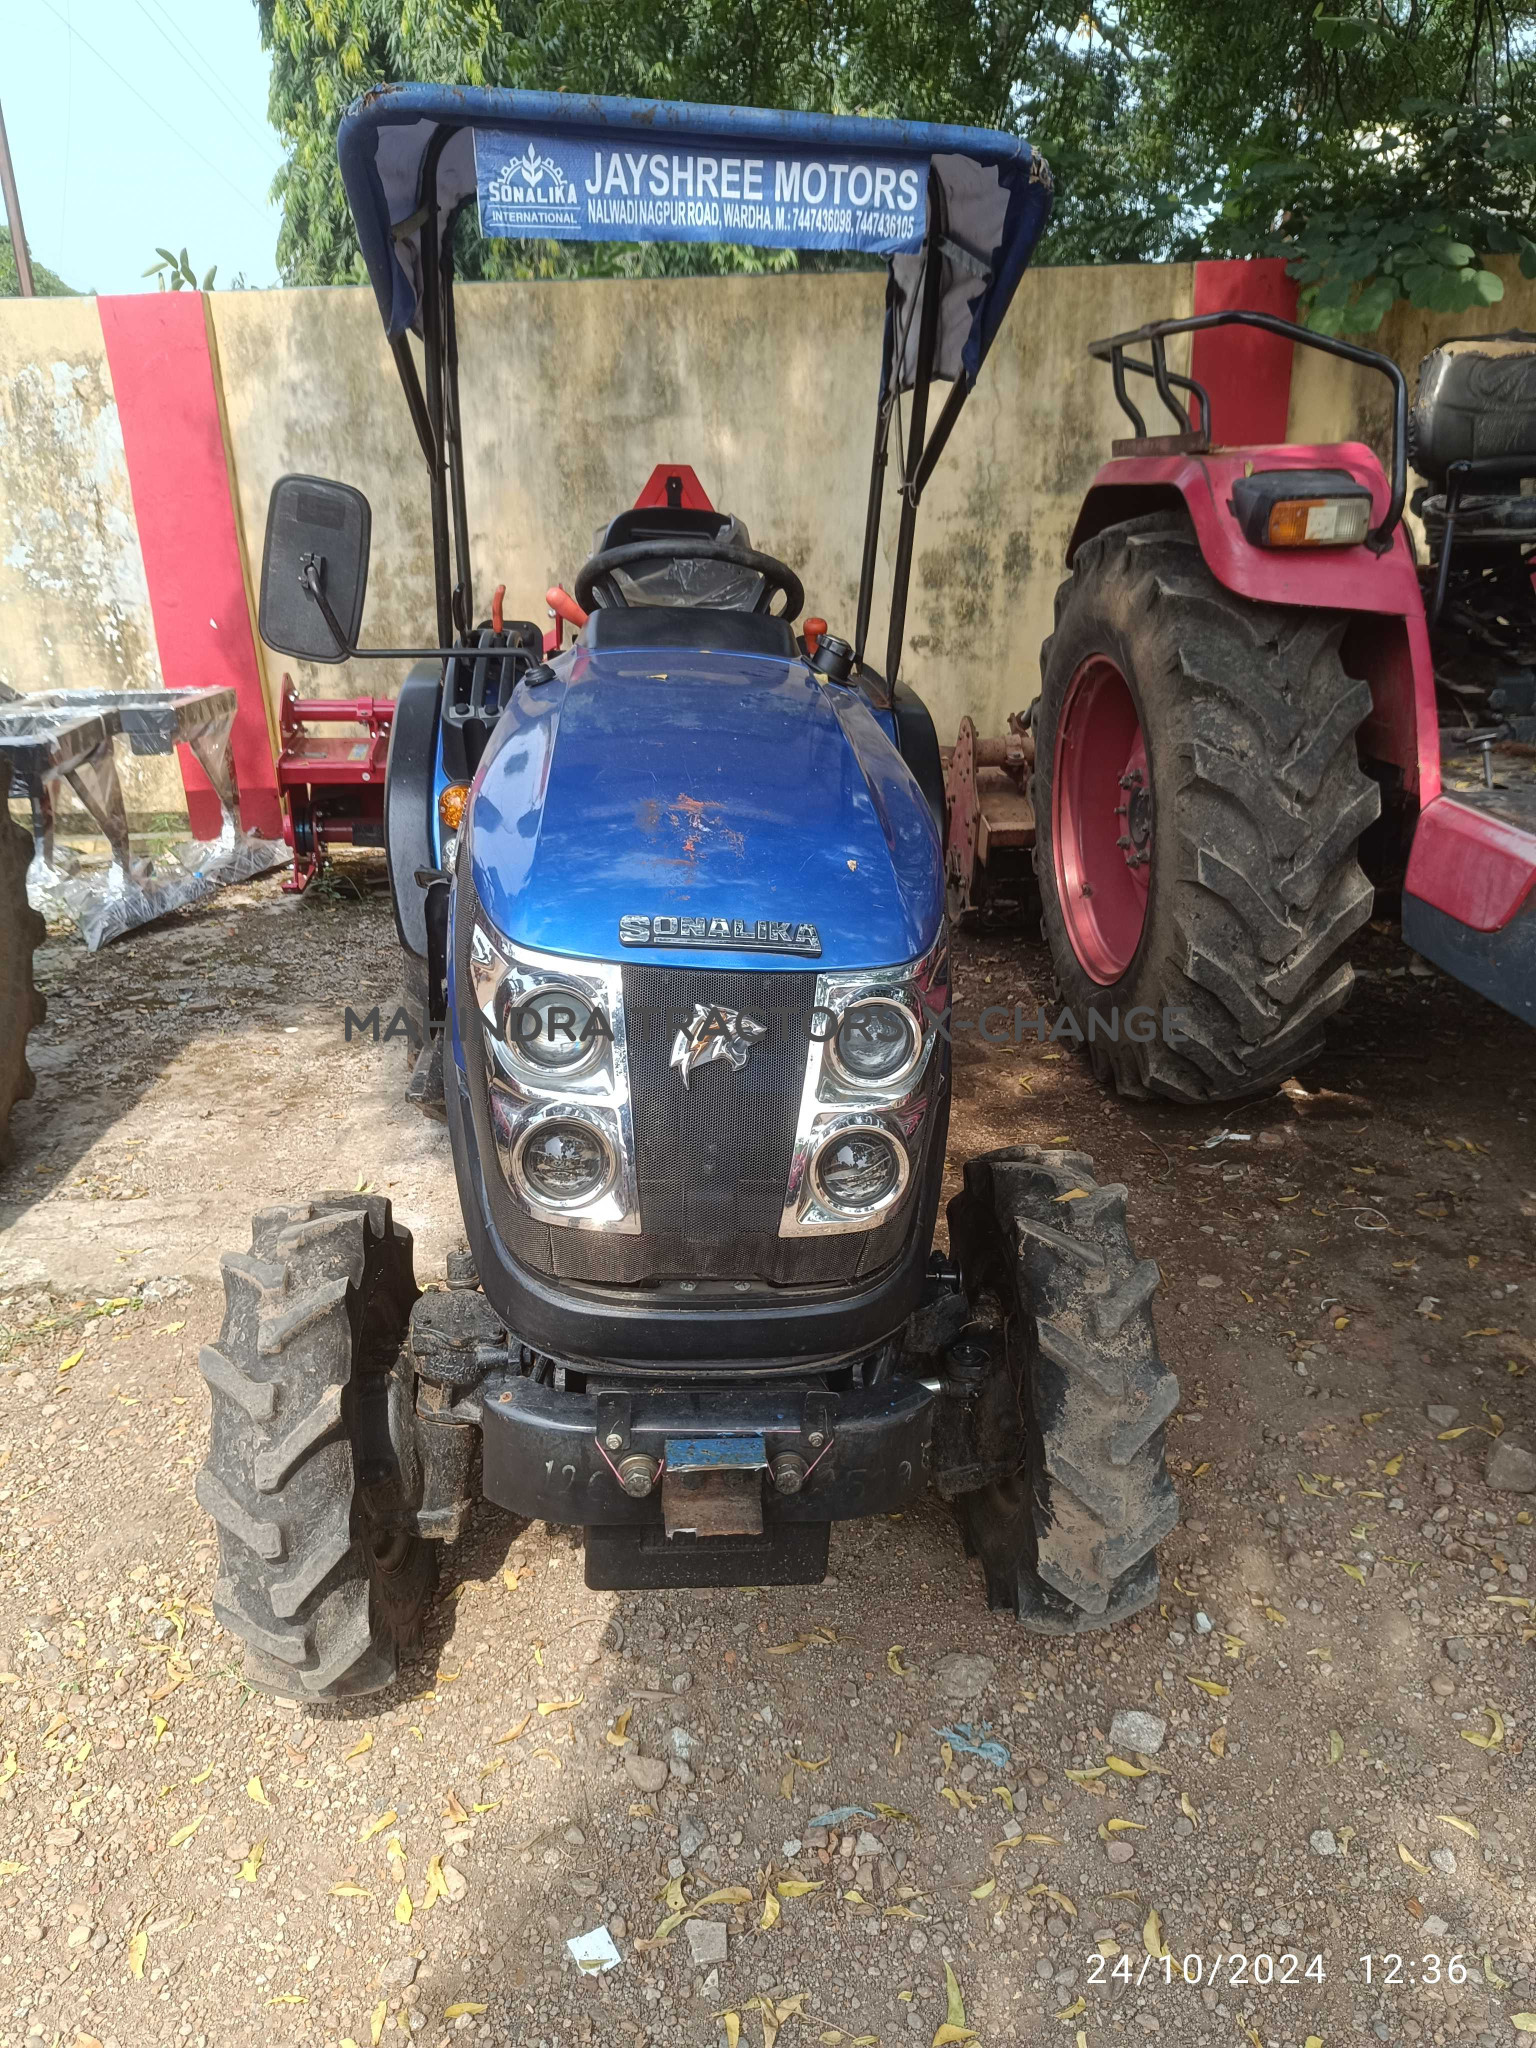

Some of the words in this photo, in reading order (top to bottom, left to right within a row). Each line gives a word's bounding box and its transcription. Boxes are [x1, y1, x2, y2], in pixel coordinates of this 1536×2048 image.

[489, 181, 578, 204] SONALIKA
[585, 151, 763, 200] JAYSHREE
[774, 161, 919, 211] MOTORS
[492, 210, 578, 224] INTERNATIONAL
[587, 198, 638, 224] NALWADI
[640, 200, 686, 226] NAGPUR
[687, 201, 722, 231] ROAD,
[619, 914, 822, 951] SONALIKA
